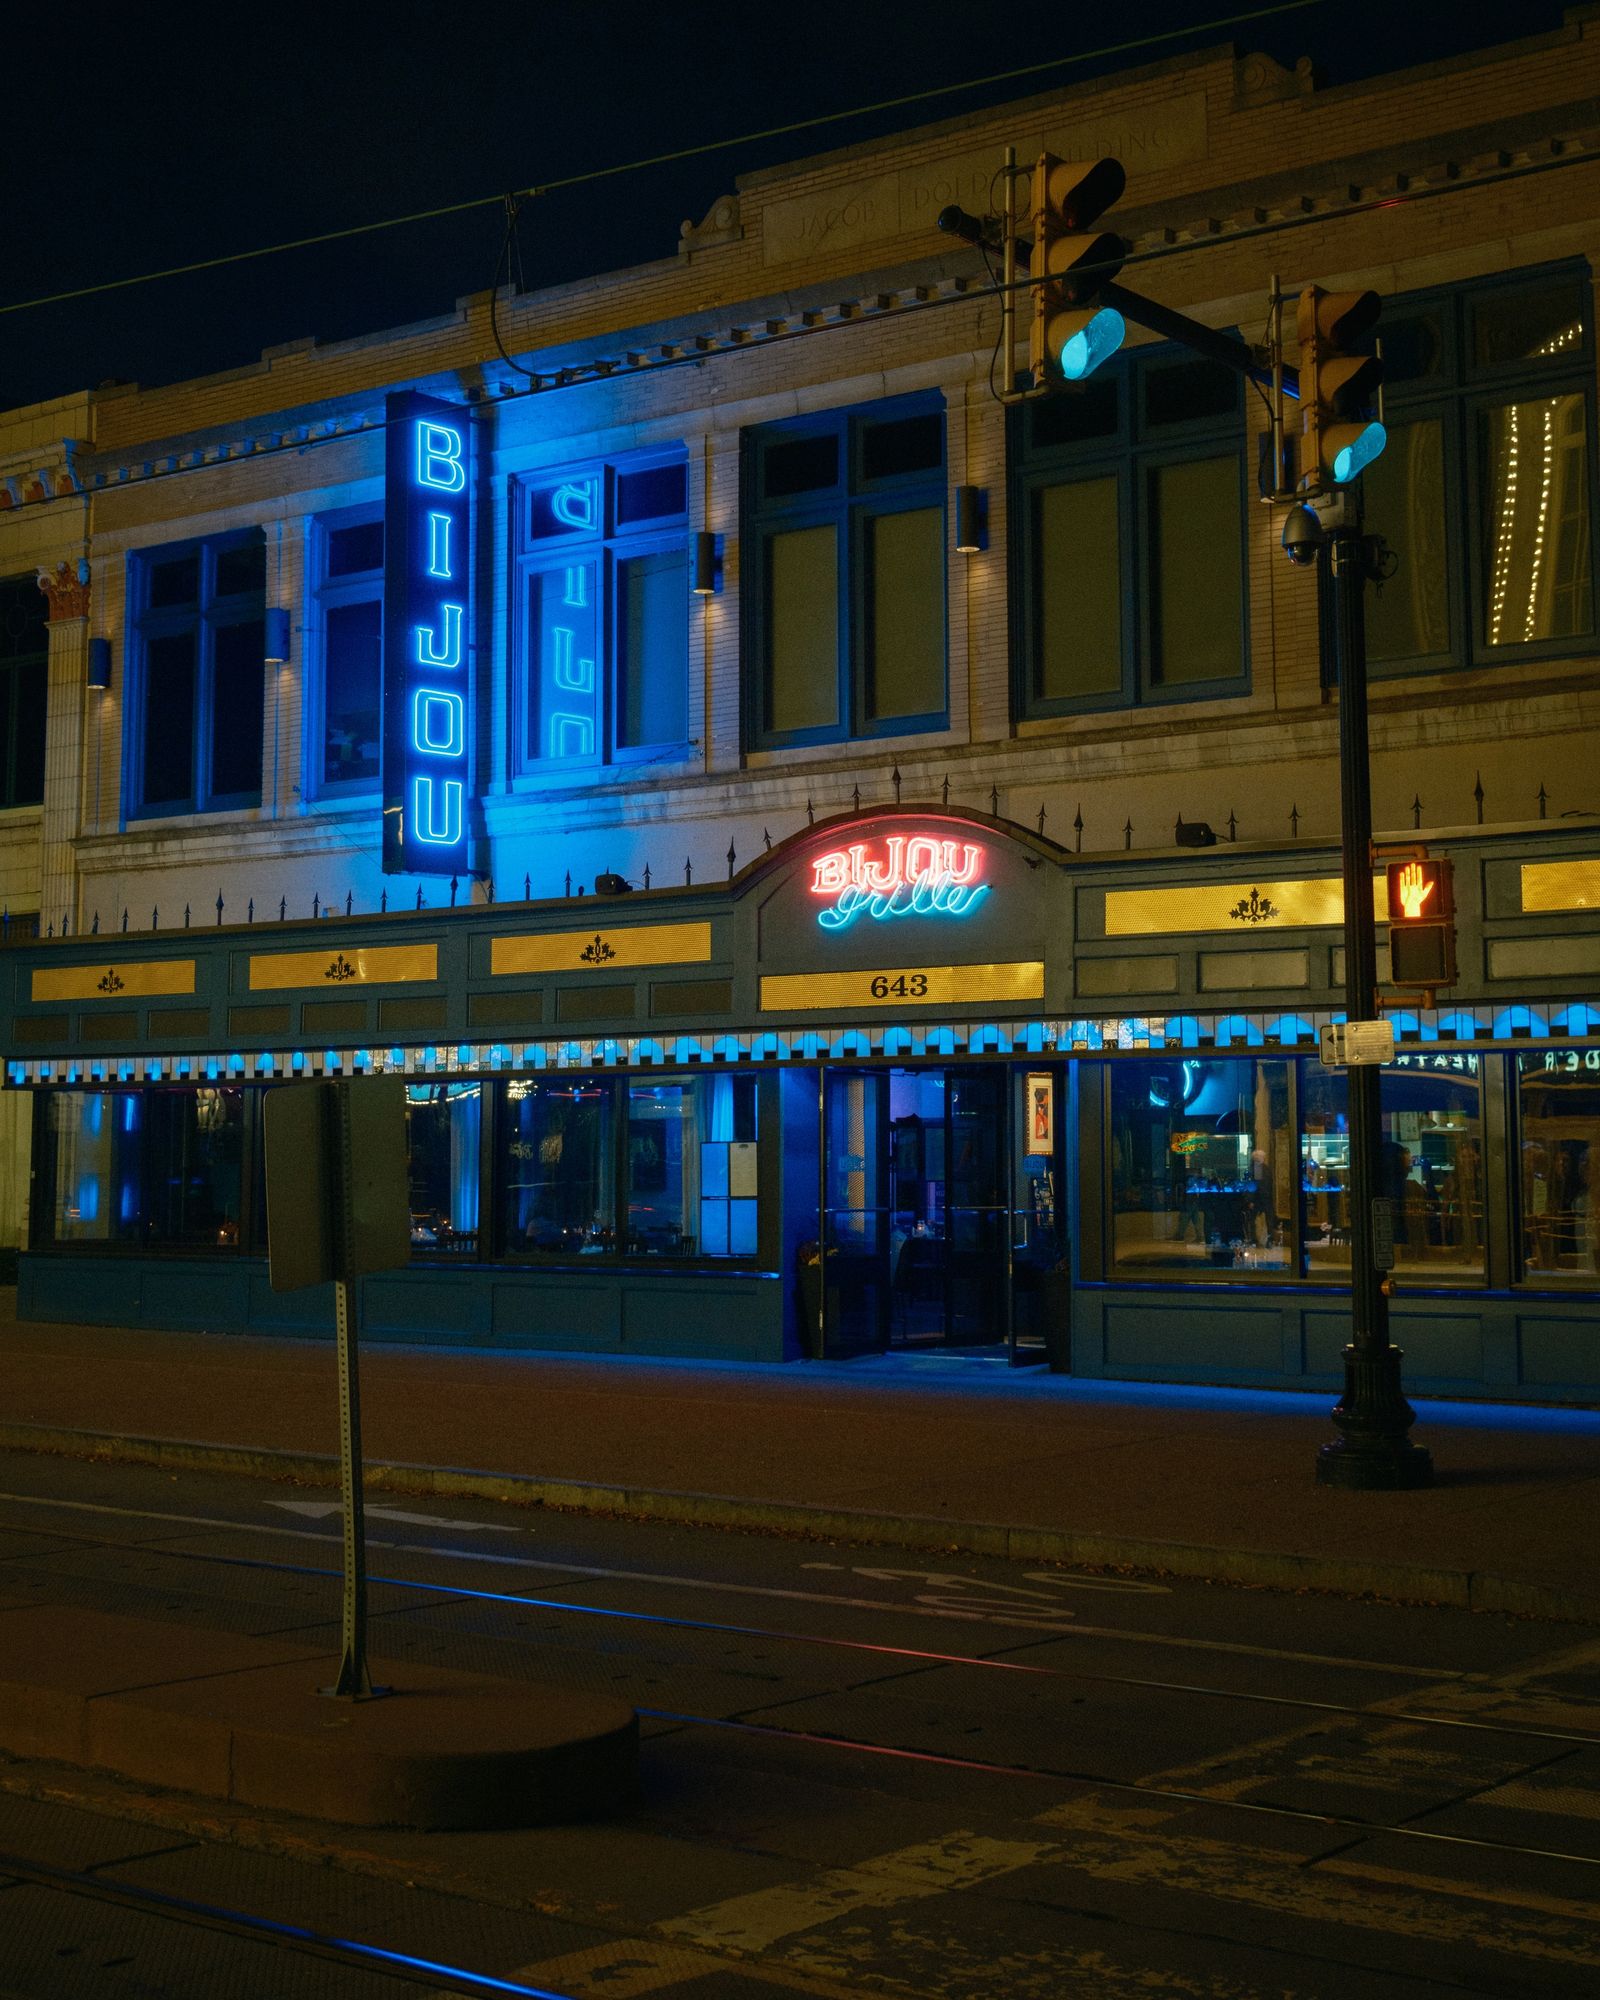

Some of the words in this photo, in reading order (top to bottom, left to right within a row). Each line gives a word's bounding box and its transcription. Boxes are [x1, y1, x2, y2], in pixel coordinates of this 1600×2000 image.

[793, 198, 876, 239] JACOB
[413, 420, 466, 846] BIJOU
[812, 838, 982, 893] BIJOU
[818, 869, 992, 928] grille
[870, 974, 928, 998] 643
